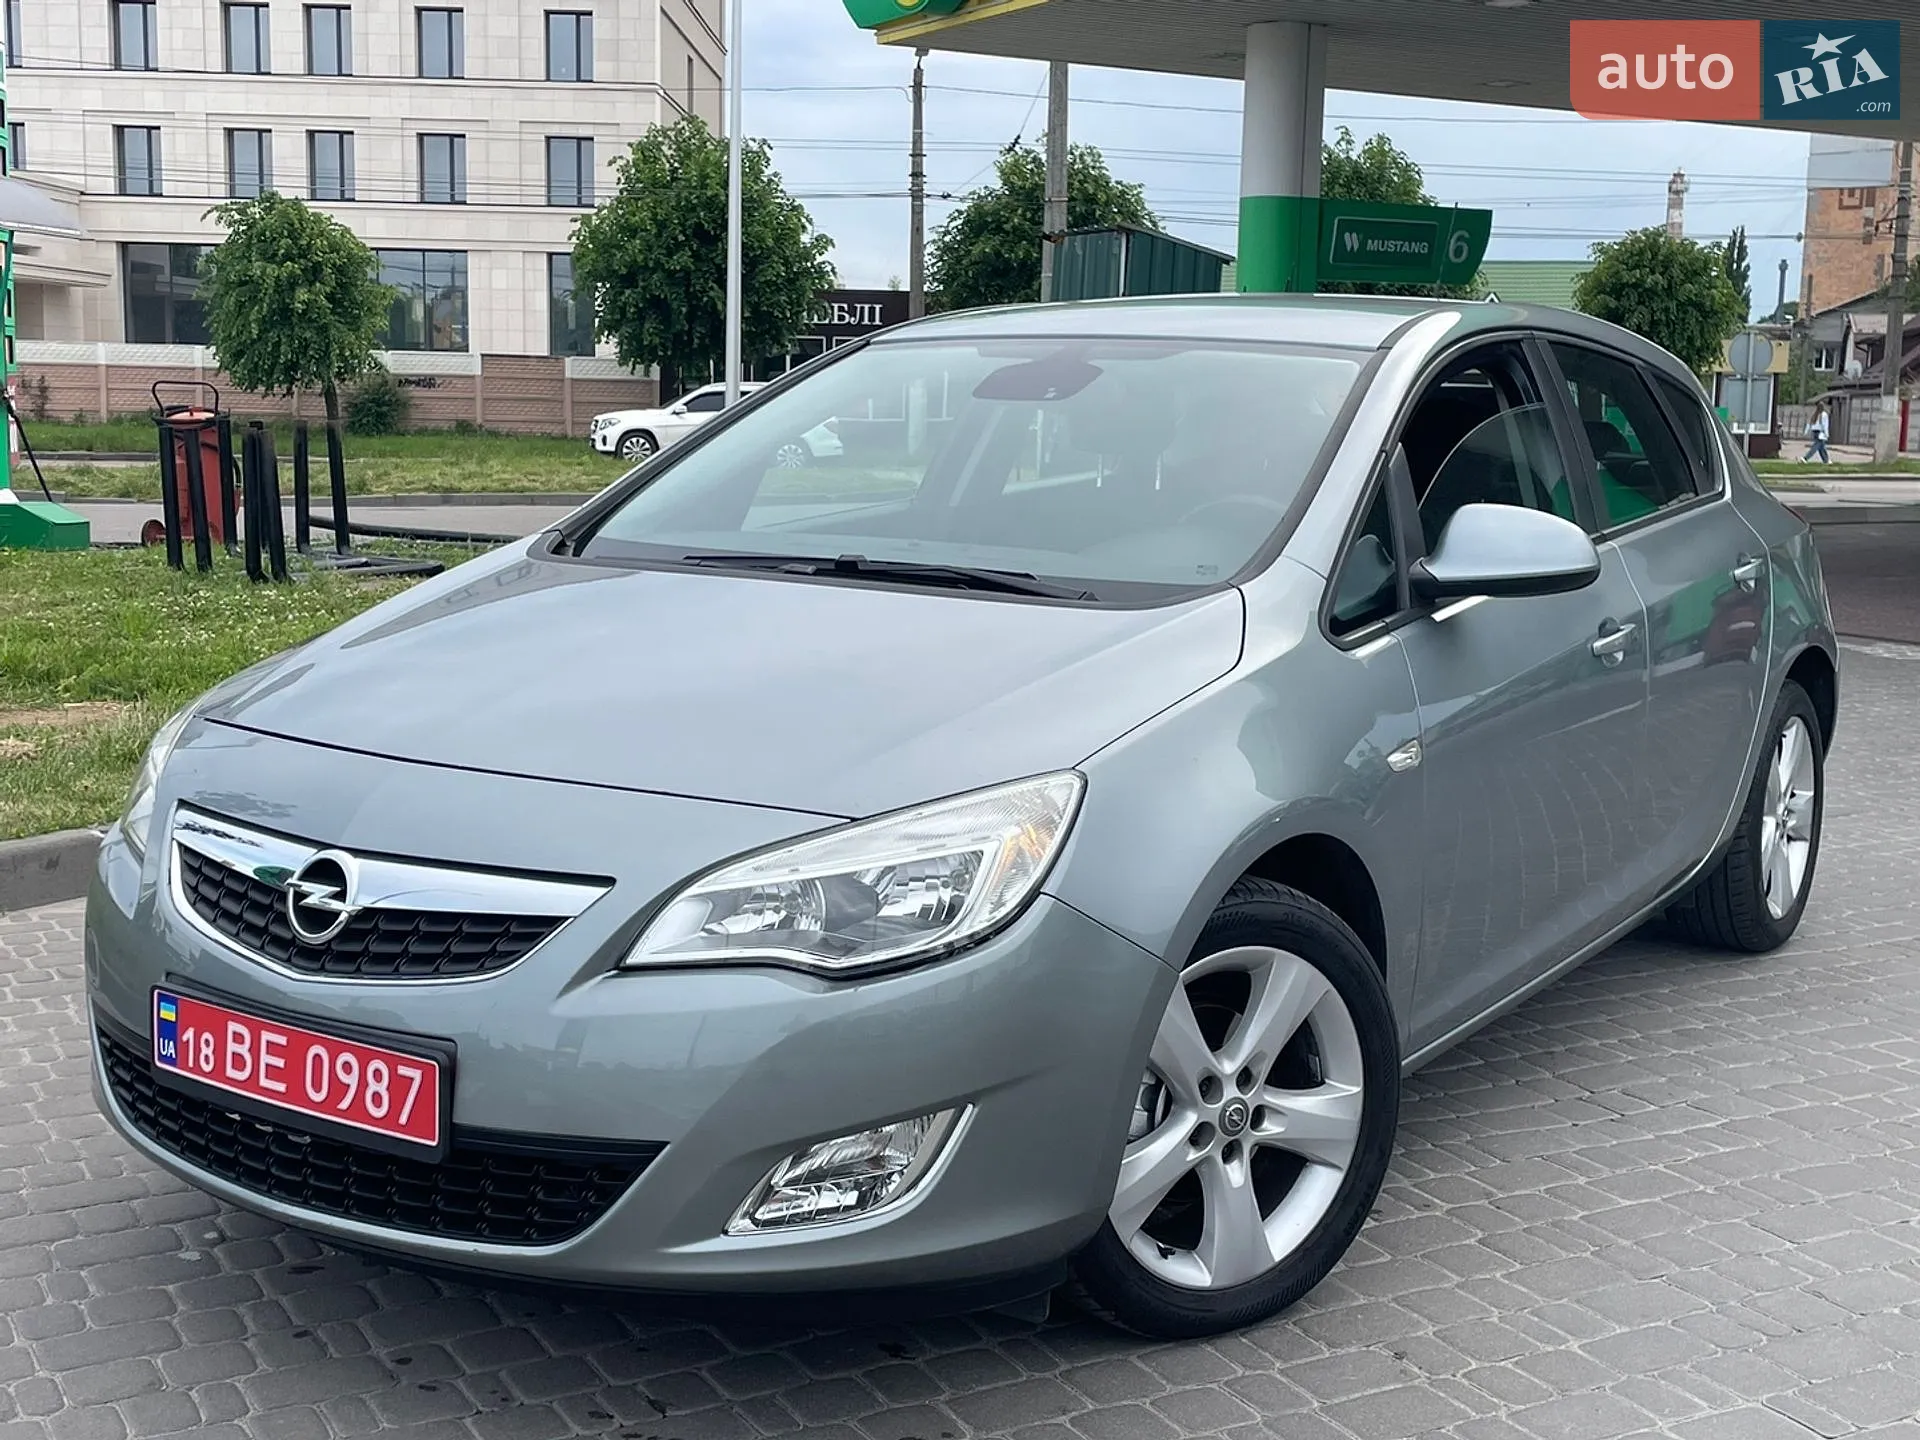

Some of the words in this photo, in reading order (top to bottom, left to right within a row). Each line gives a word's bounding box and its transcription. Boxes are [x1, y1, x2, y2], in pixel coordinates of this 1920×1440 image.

[1366, 239, 1430, 254] MUSTANG
[1448, 230, 1470, 263] 6
[803, 302, 883, 325] БЛІ
[159, 1037, 176, 1059] UA
[181, 1026, 215, 1073] 18
[225, 1020, 288, 1093] BE
[304, 1044, 424, 1126] 0987
